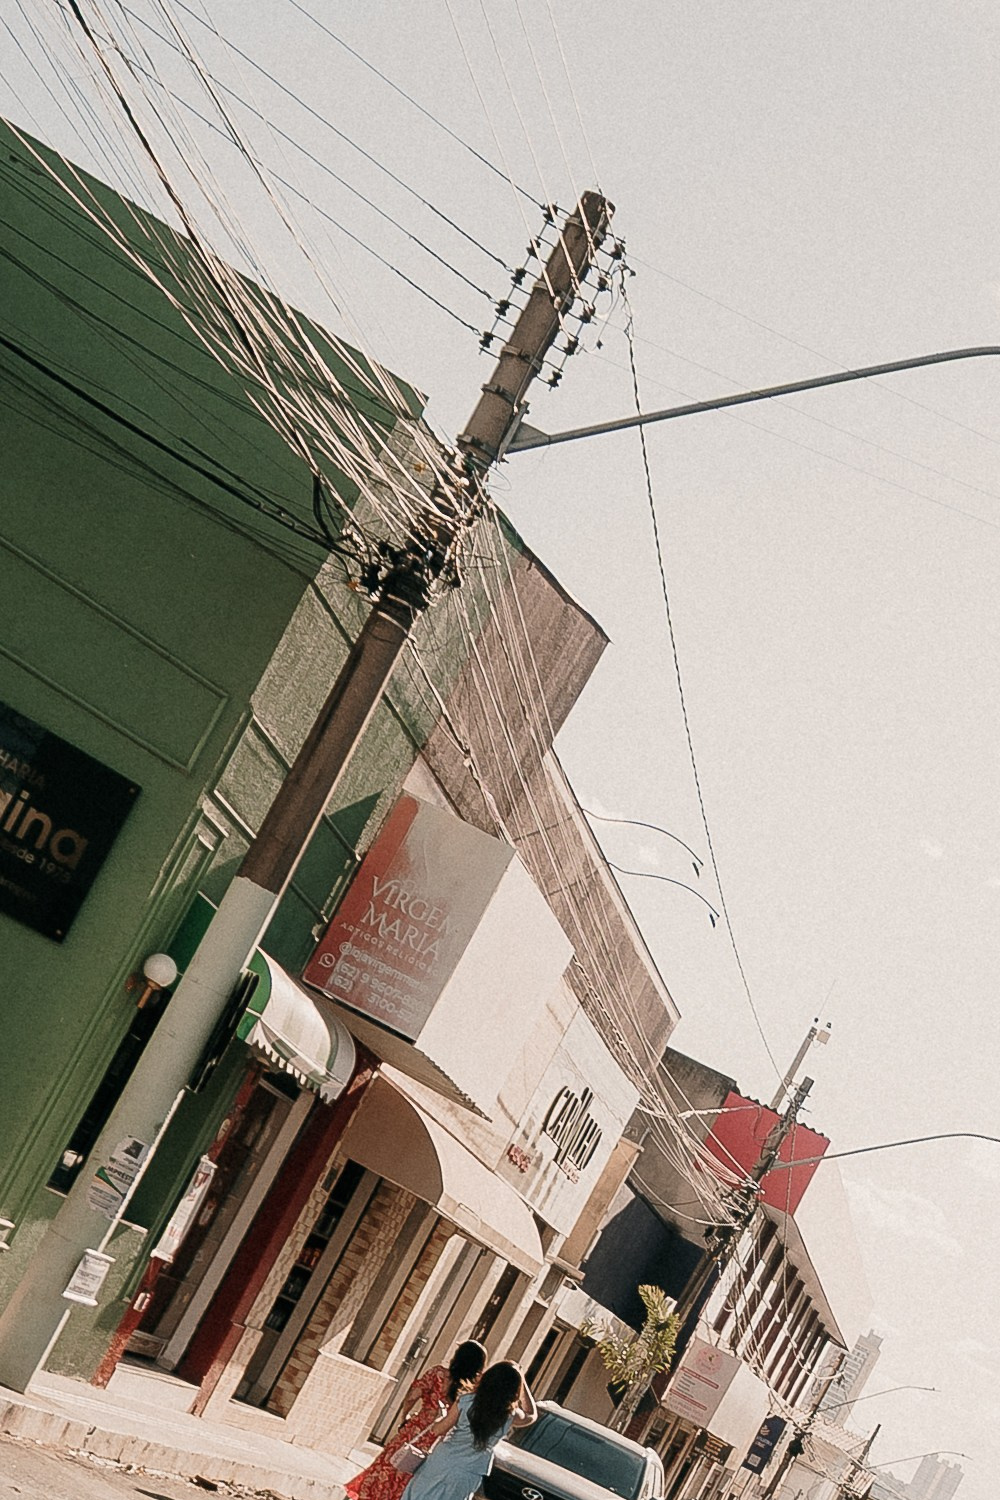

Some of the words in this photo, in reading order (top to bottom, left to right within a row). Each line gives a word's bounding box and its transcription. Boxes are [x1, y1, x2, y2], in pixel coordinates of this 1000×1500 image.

[340, 922, 385, 948] ARTIGOS
[386, 944, 442, 978] RELIGIOSO
[361, 901, 439, 961] MARIA
